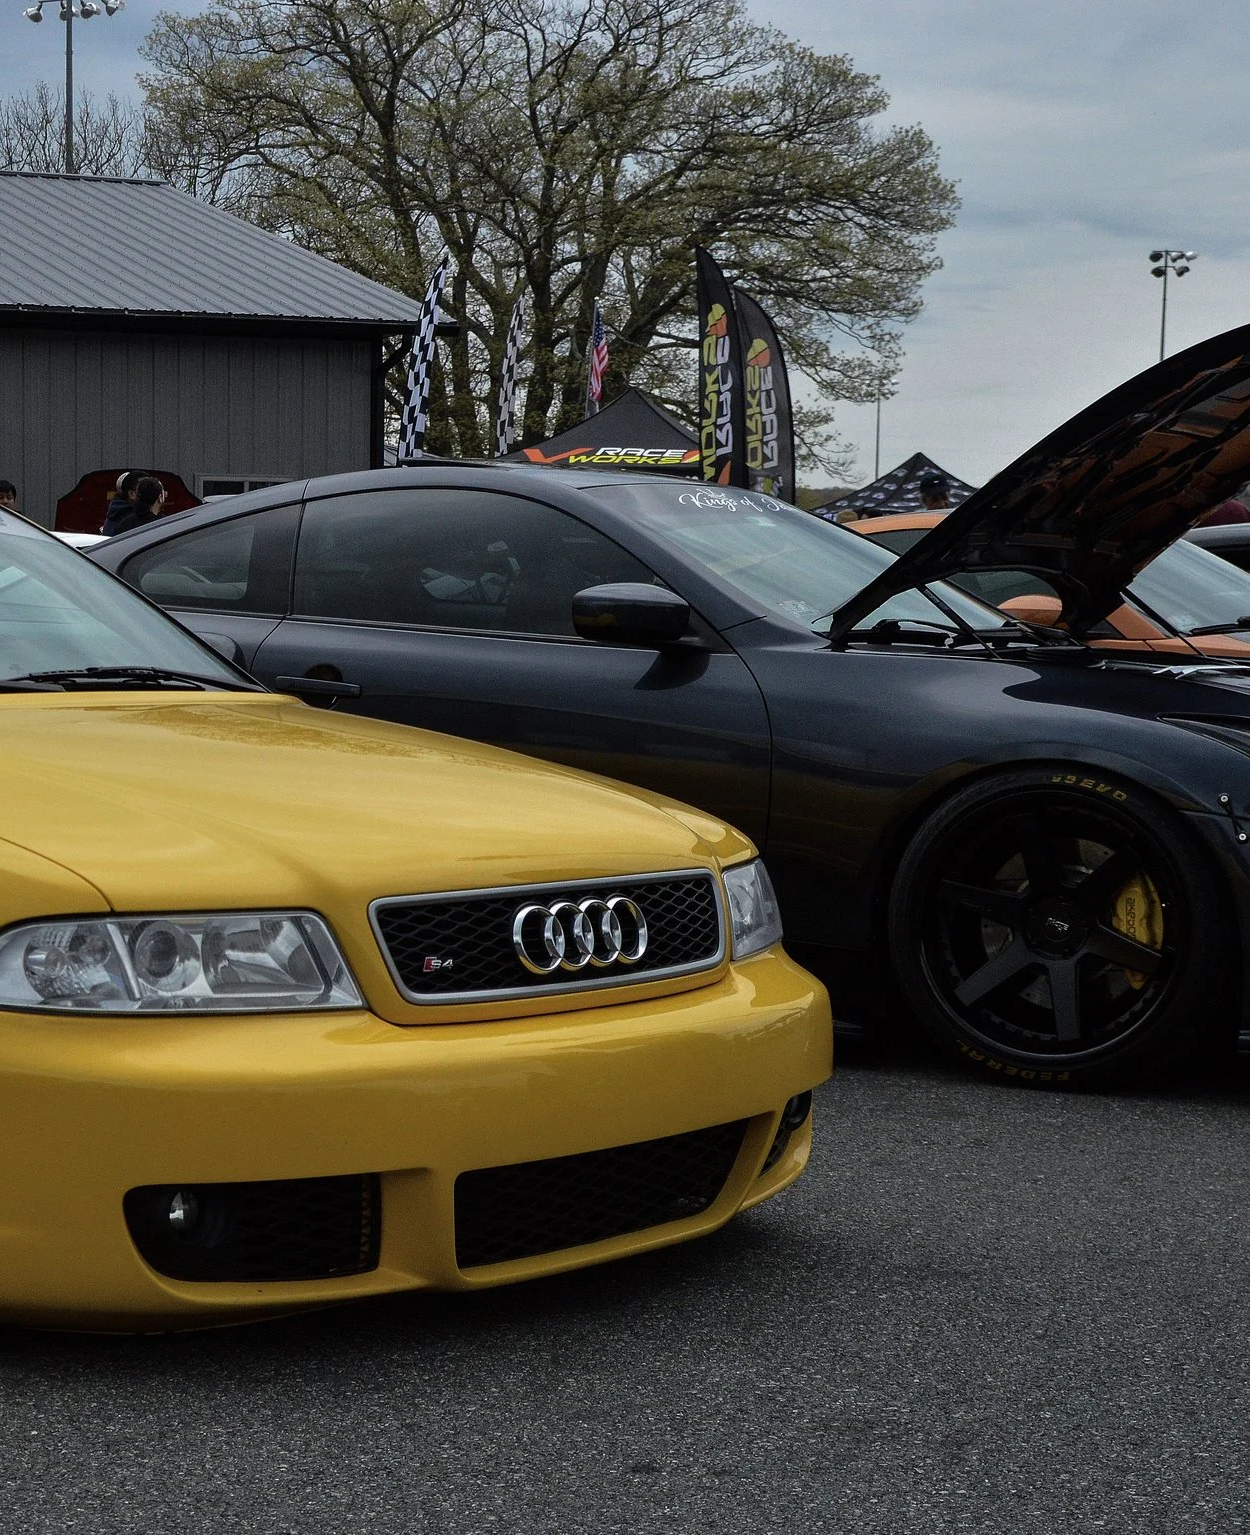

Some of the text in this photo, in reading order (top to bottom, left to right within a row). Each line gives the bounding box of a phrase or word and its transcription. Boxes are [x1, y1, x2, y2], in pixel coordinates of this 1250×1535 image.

[595, 447, 688, 458] RACE
[568, 455, 683, 465] WORKS
[678, 489, 737, 513] Kings
[430, 958, 454, 969] S4
